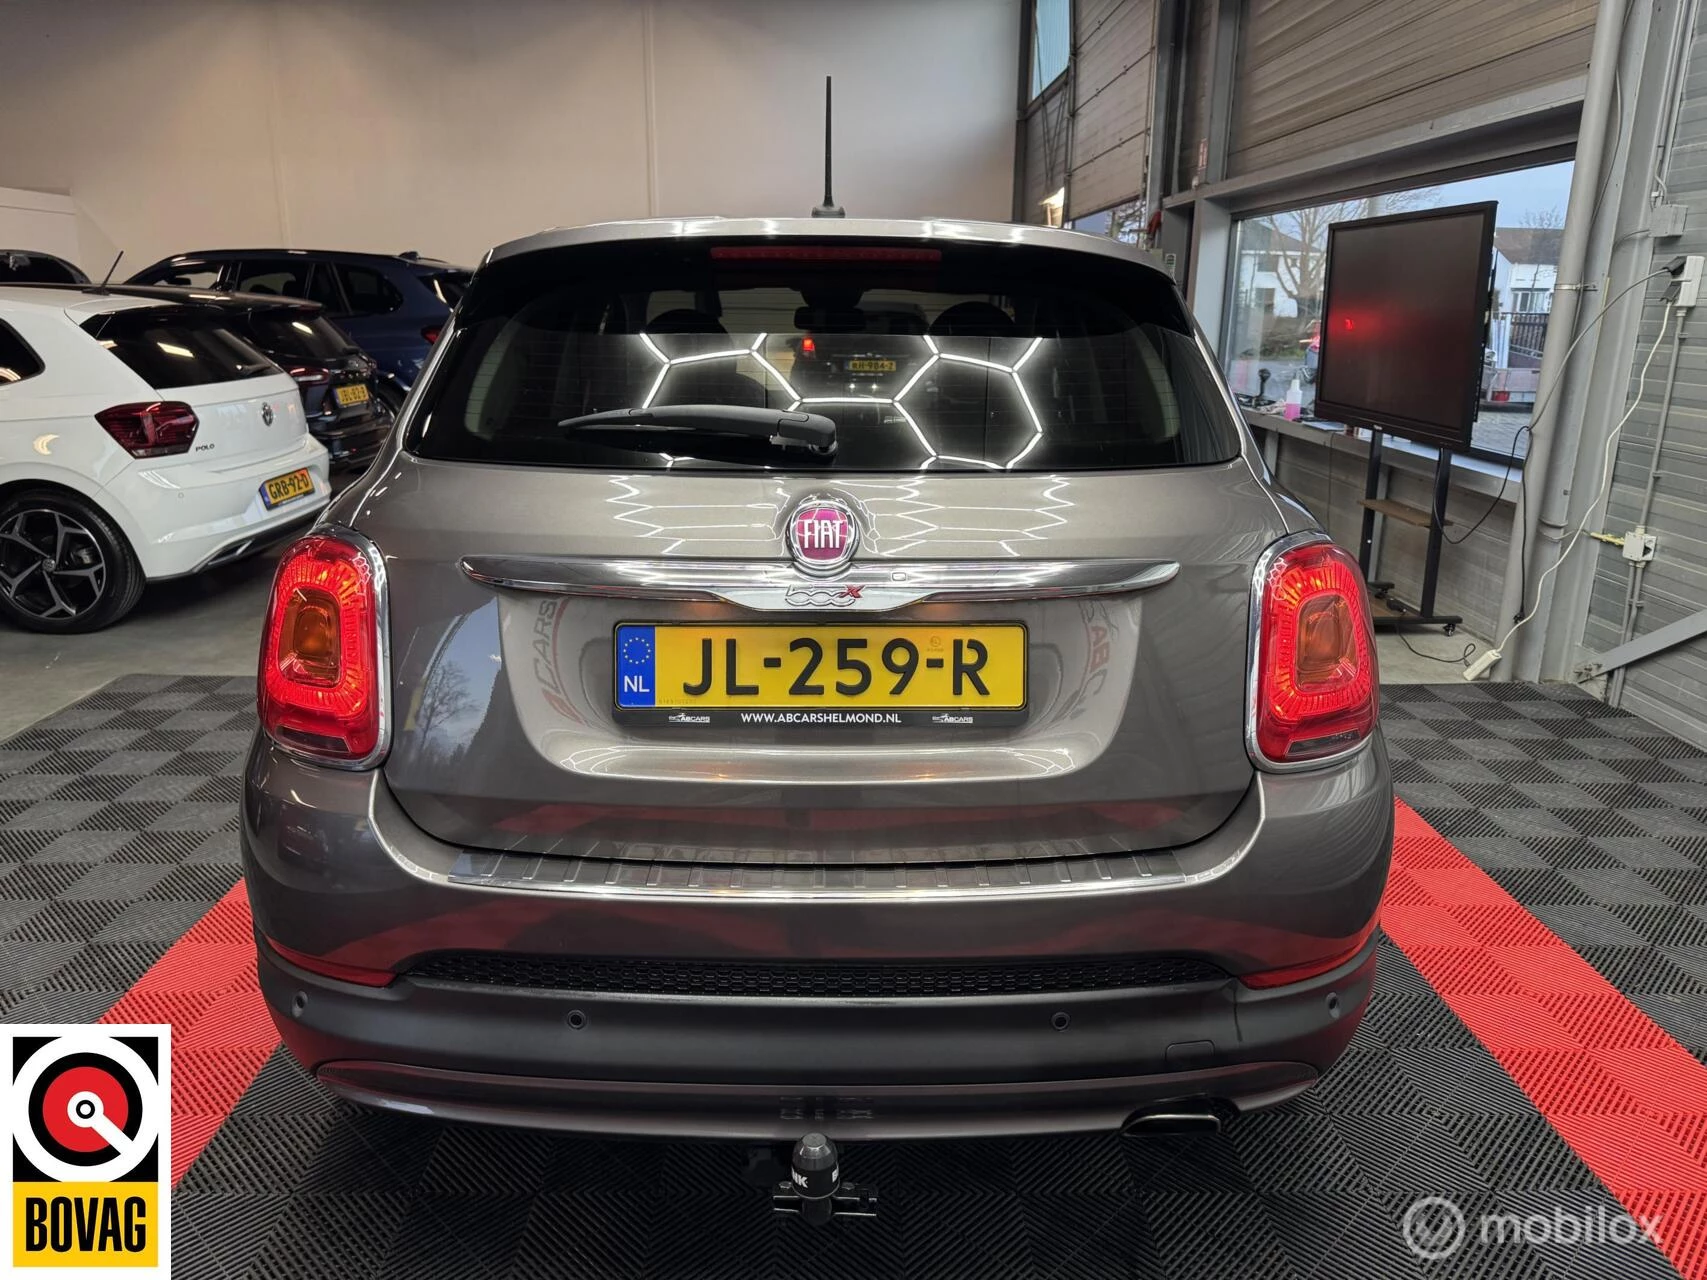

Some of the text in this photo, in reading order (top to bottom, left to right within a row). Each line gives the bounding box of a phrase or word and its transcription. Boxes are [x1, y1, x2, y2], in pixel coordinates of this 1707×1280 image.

[195, 443, 215, 452] POLO
[268, 474, 309, 500] GRB-92-D
[803, 519, 843, 549] FIAT
[682, 637, 991, 696] JL-259-R
[623, 675, 651, 693] NL
[740, 712, 902, 724] WWW.ABCARSHELMOND.NL
